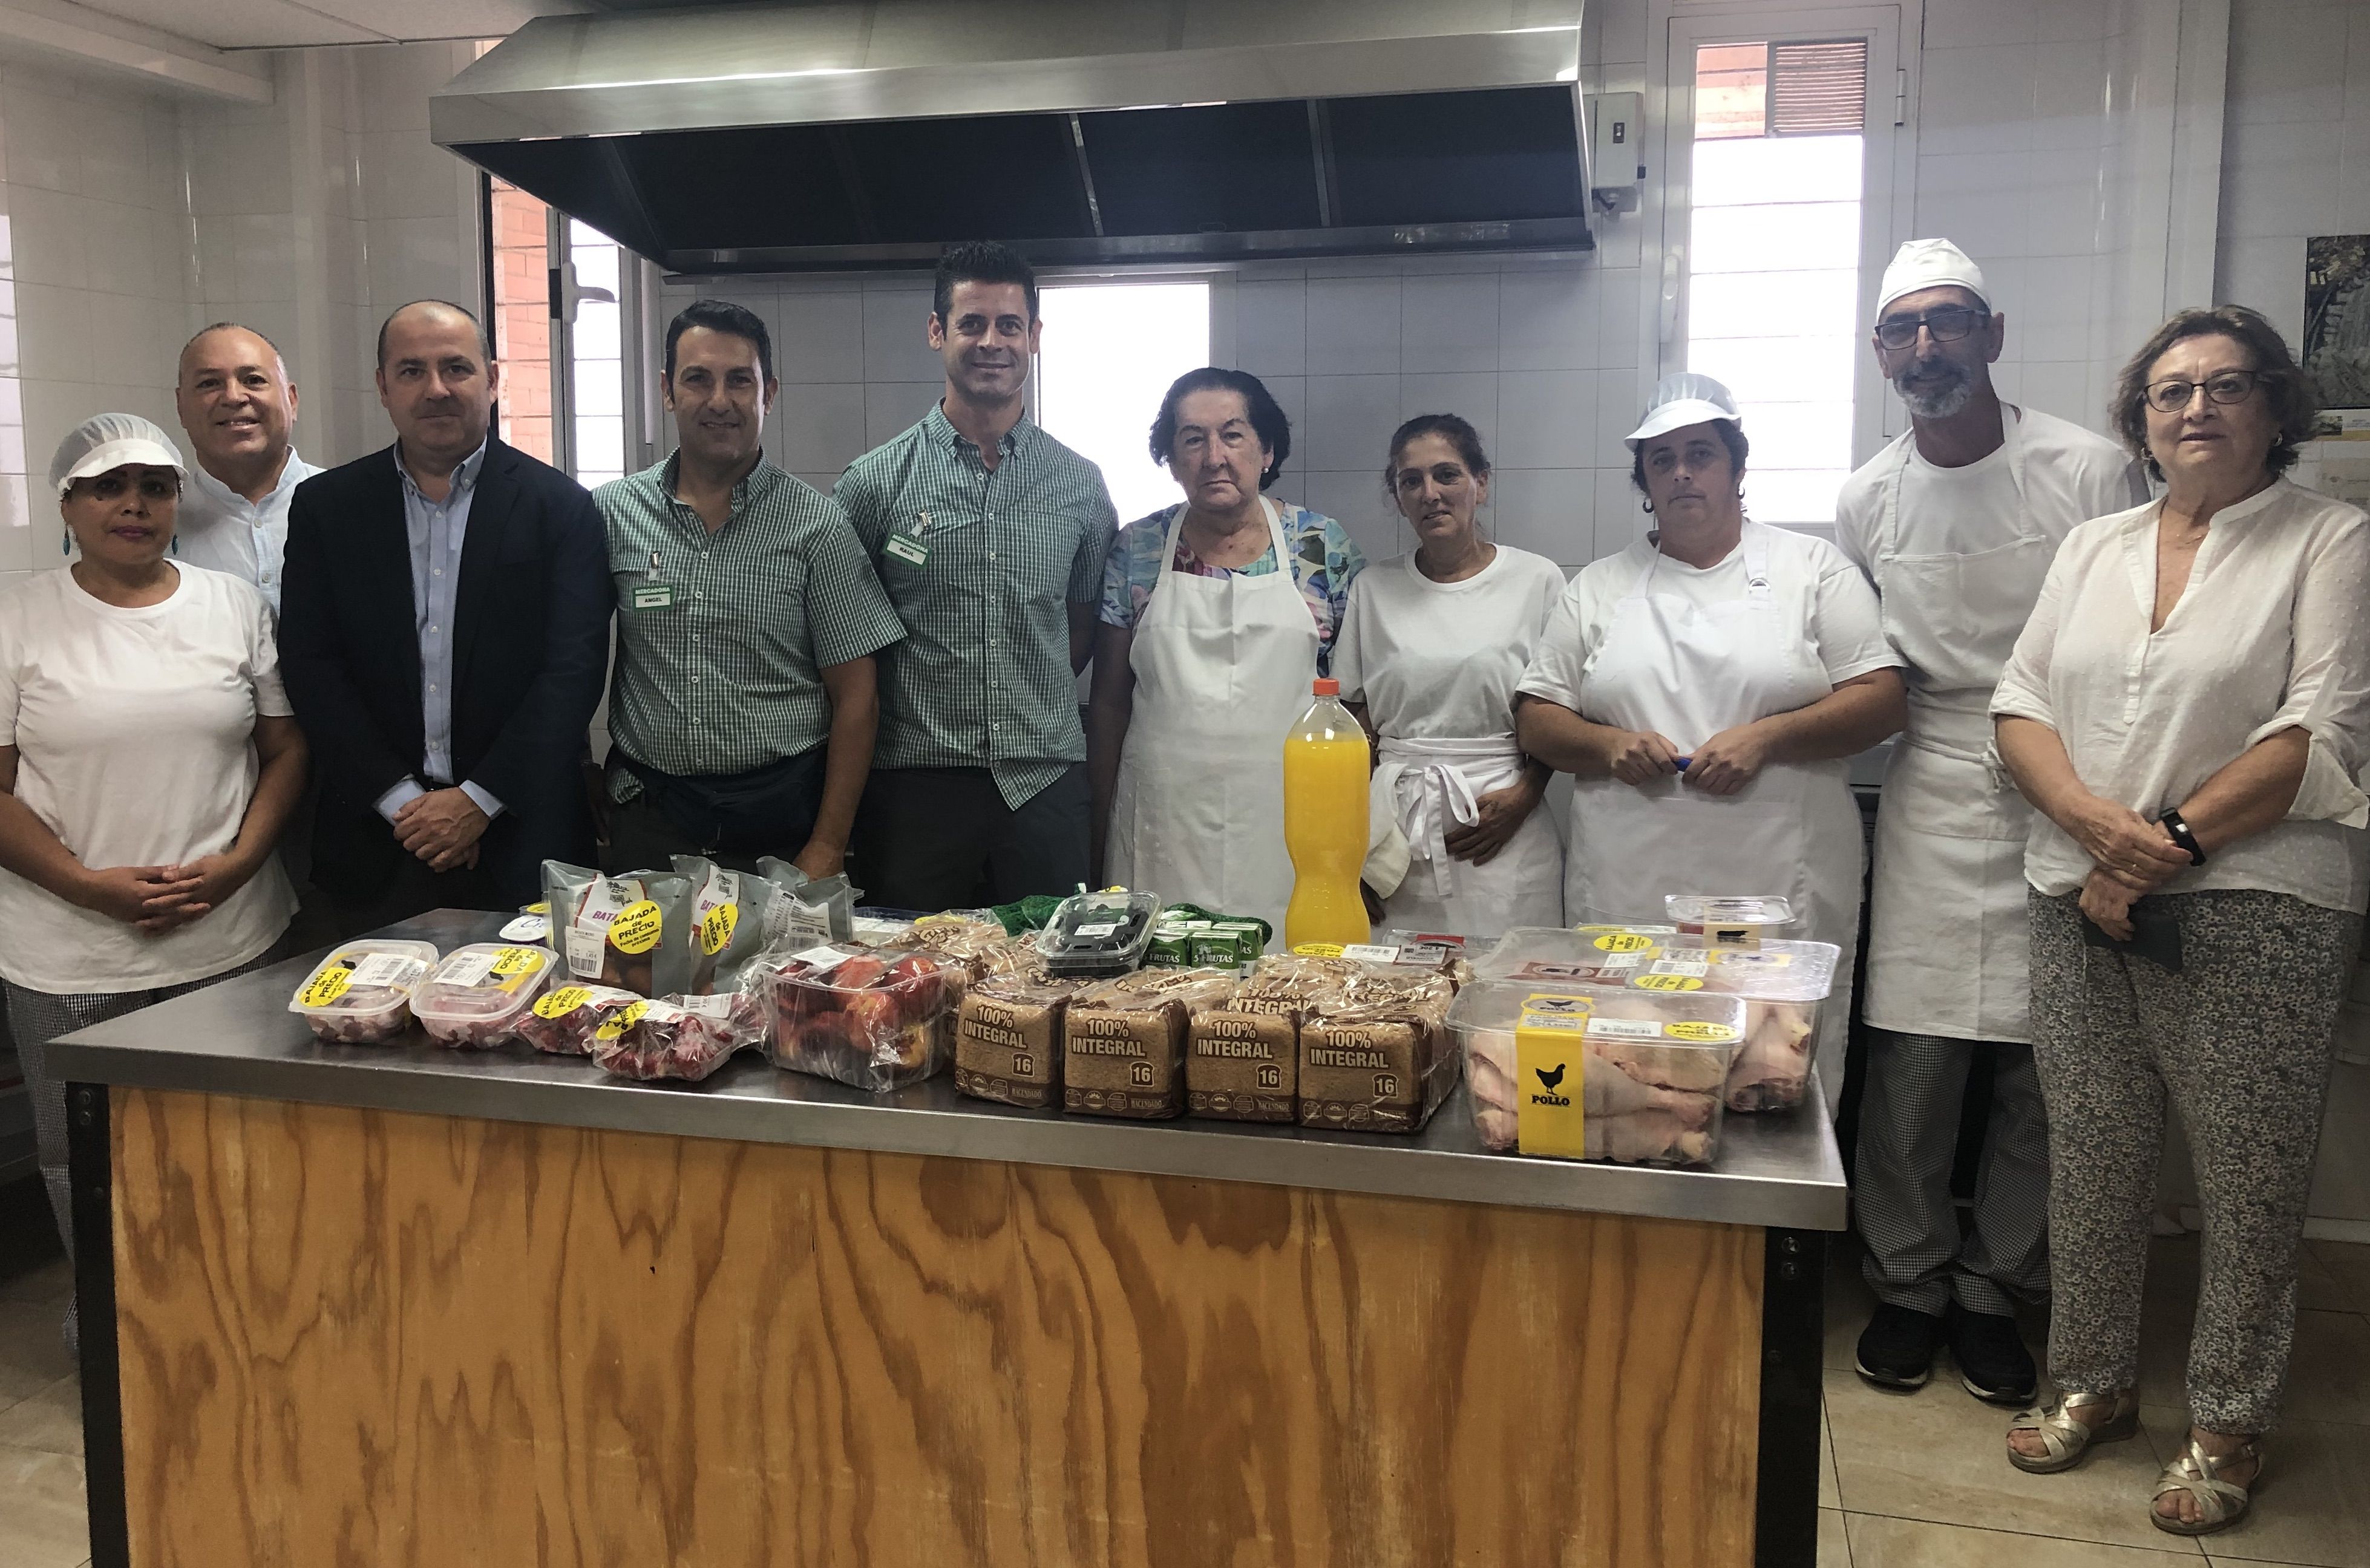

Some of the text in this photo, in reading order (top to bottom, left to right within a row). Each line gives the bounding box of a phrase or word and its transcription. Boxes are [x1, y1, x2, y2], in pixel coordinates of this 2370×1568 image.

[891, 534, 928, 554] MERCADONA
[899, 547, 914, 557] RAUL
[700, 899, 718, 913] BAT
[614, 906, 657, 926] BAJADA
[719, 904, 730, 938] BAJADA
[618, 921, 655, 940] PRECIO
[707, 917, 719, 946] PRECIO
[1150, 953, 1180, 963] FRUTAS
[1202, 954, 1234, 963] FRUTAS
[304, 970, 328, 1004] BAJADA
[319, 972, 342, 998] PRECIO
[978, 1005, 1013, 1028] 100%
[964, 1019, 1027, 1048] INTEGRAL
[1088, 1019, 1129, 1037] 100%
[1214, 1021, 1256, 1039] 100%
[1073, 1037, 1146, 1057] INTEGRAL
[1327, 1031, 1371, 1048] 100%
[1197, 1039, 1272, 1059] INTEGRAL
[1311, 1048, 1389, 1068] INTEGRAL
[1015, 1057, 1032, 1073] 16
[1133, 1067, 1150, 1082] 16
[1260, 1070, 1278, 1085] 16
[1376, 1078, 1395, 1094] 16
[1532, 1095, 1570, 1106] POLLO
